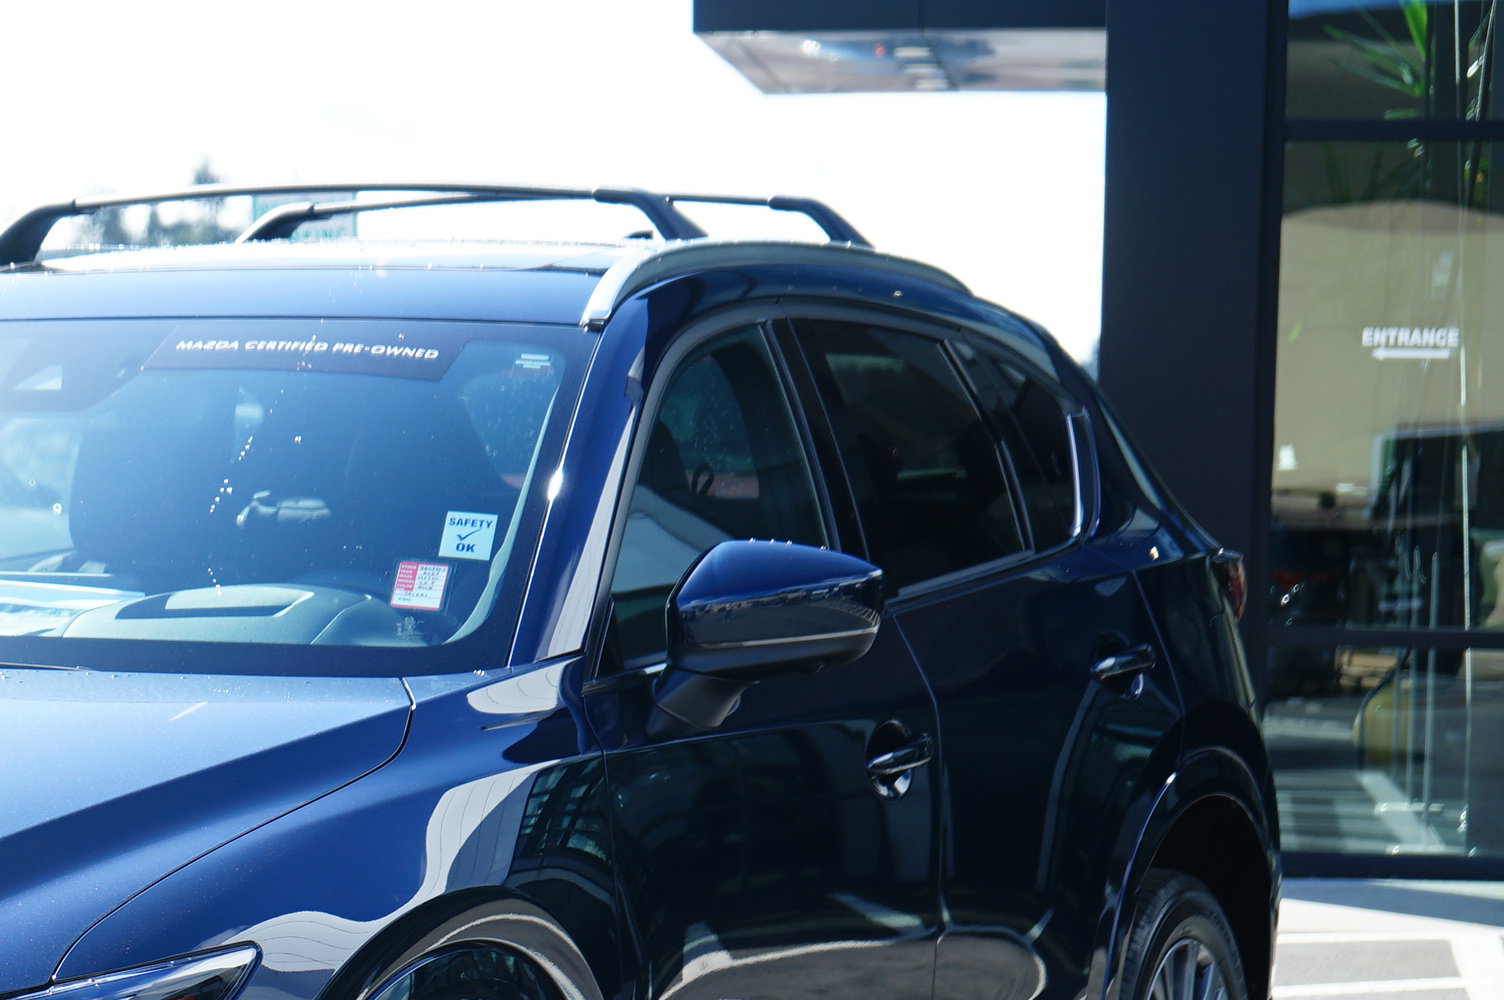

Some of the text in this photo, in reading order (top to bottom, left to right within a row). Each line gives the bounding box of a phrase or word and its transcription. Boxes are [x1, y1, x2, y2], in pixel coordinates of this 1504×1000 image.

[1361, 327, 1460, 346] ENTRANCE
[176, 340, 439, 359] MAZDA CERTIFIED PRE-OWNED
[449, 517, 493, 528] SAFETY
[456, 542, 476, 552] OK
